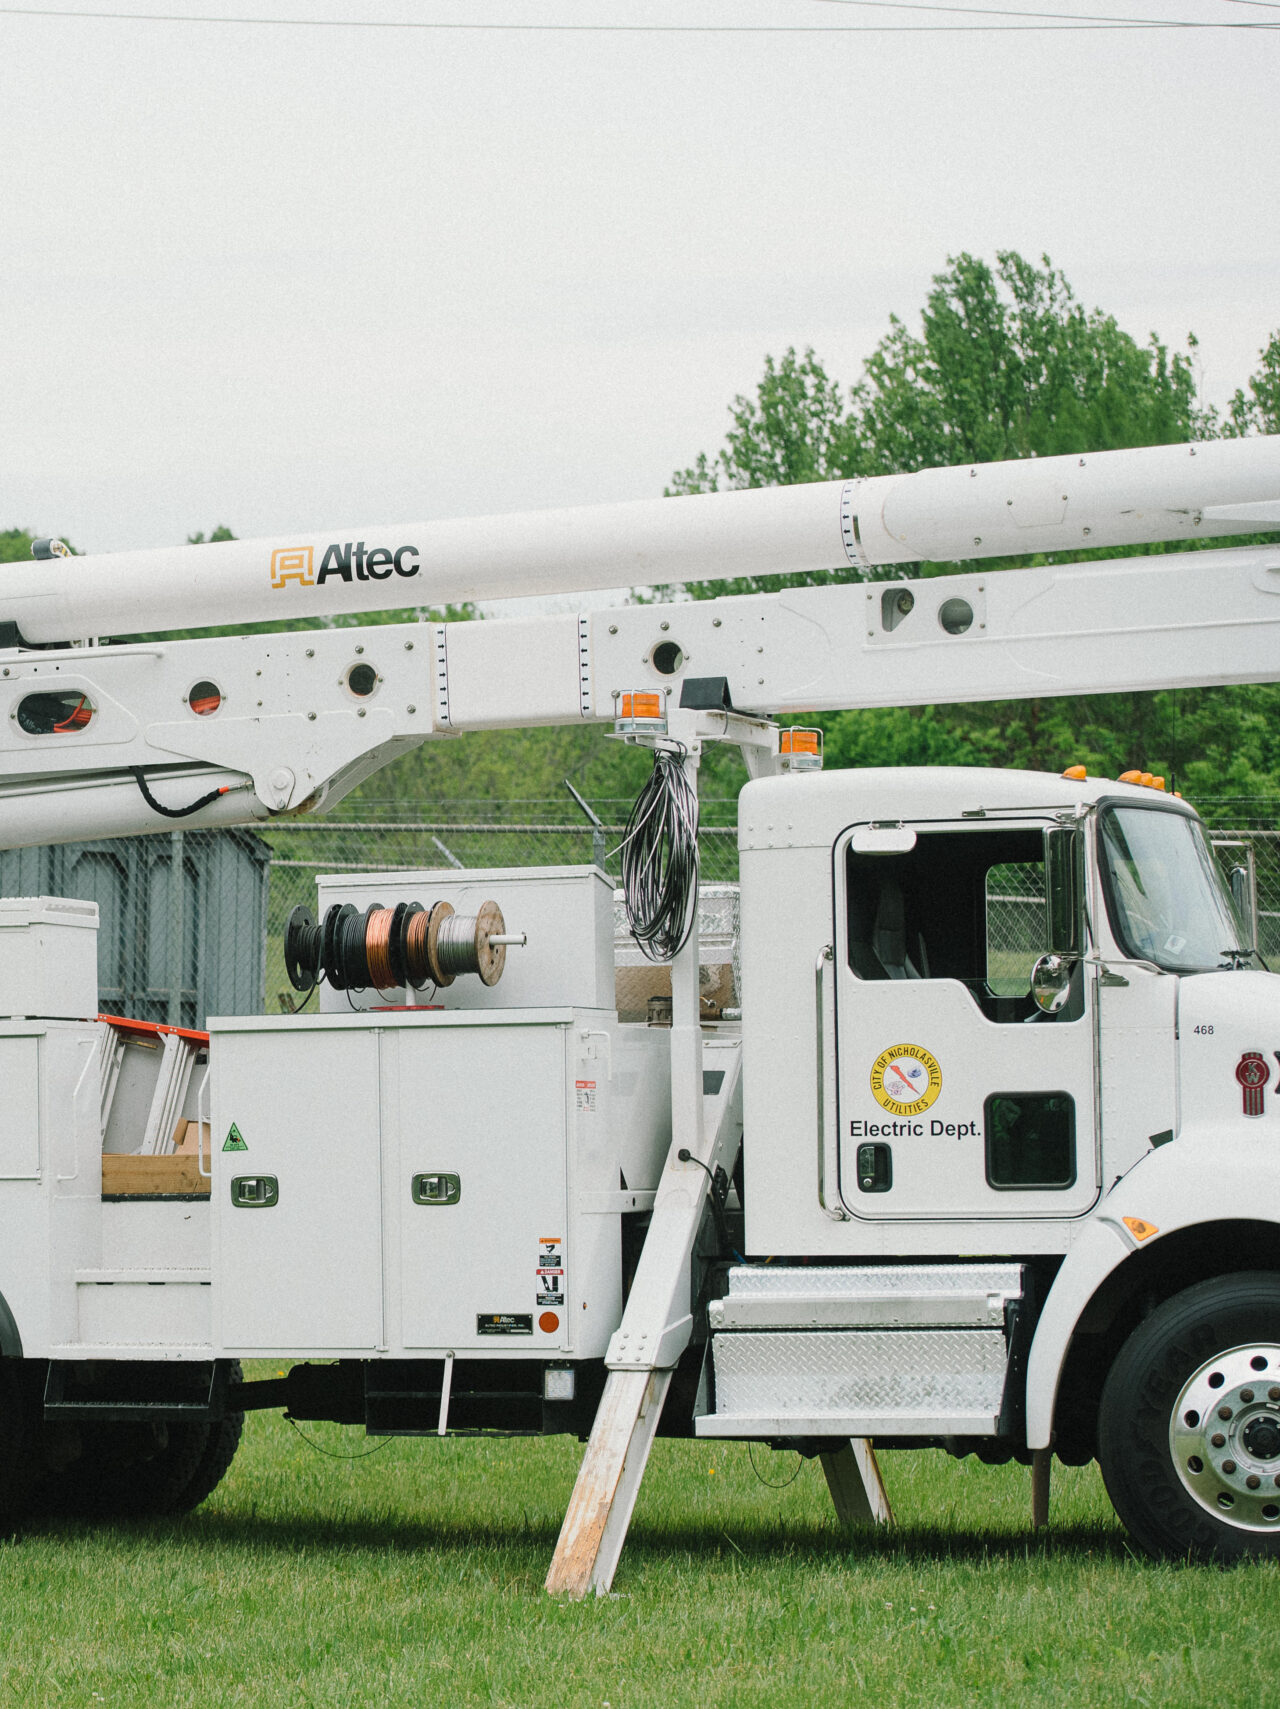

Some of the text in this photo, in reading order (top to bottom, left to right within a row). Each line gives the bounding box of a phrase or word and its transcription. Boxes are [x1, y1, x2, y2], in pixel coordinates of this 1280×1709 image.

[316, 541, 420, 585] Altec
[1193, 1025, 1215, 1035] 468
[872, 1046, 940, 1090] CITY OF NICHOLASVILLE
[882, 1098, 929, 1115] UTILITIES
[850, 1120, 982, 1141] Electric Dept.
